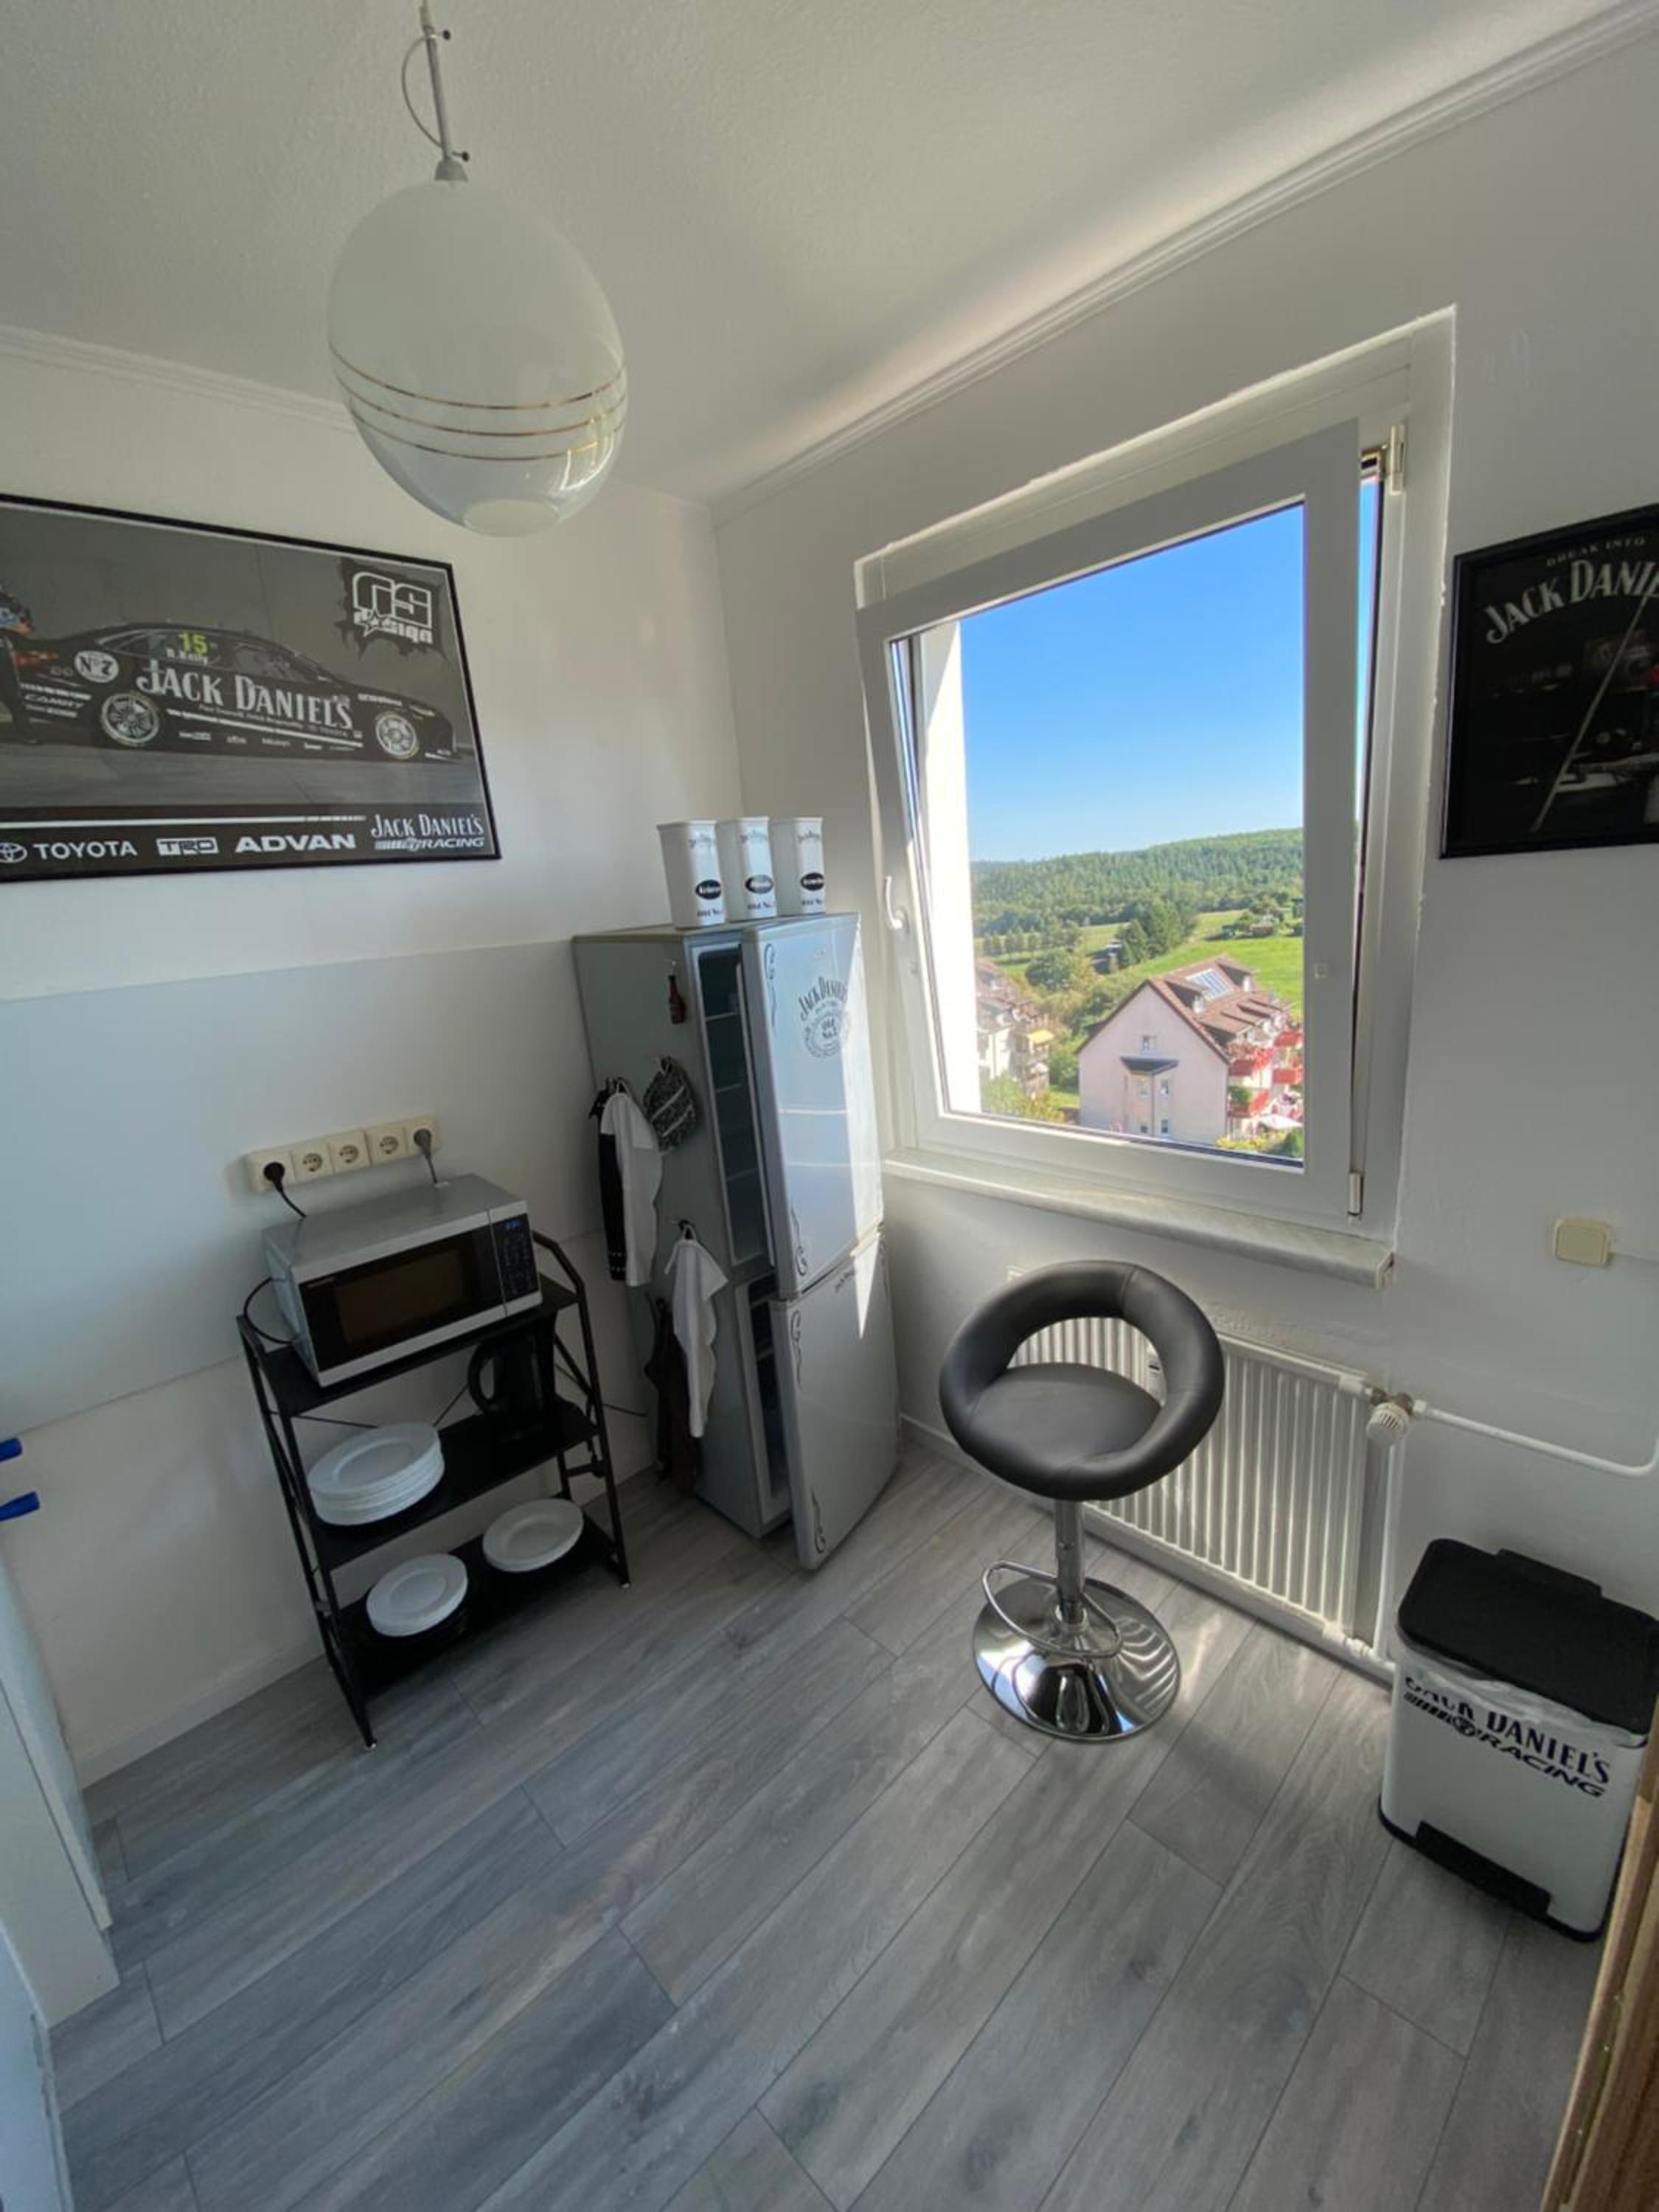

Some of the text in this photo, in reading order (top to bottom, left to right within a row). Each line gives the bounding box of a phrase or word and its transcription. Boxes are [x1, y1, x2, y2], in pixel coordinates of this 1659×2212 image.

[1485, 579, 1565, 644] JACK
[178, 632, 208, 655] 15
[136, 659, 224, 706] JACK
[234, 674, 353, 730] DANIEL'S
[371, 814, 484, 838] JACK DANIEL'S
[33, 841, 138, 859] TOYOTA
[156, 838, 219, 856] TRD
[235, 834, 356, 853] ADVAN
[422, 838, 484, 848] RACING
[1486, 1711, 1610, 1784] DANIEL'S
[1480, 1734, 1605, 1798] RACING
